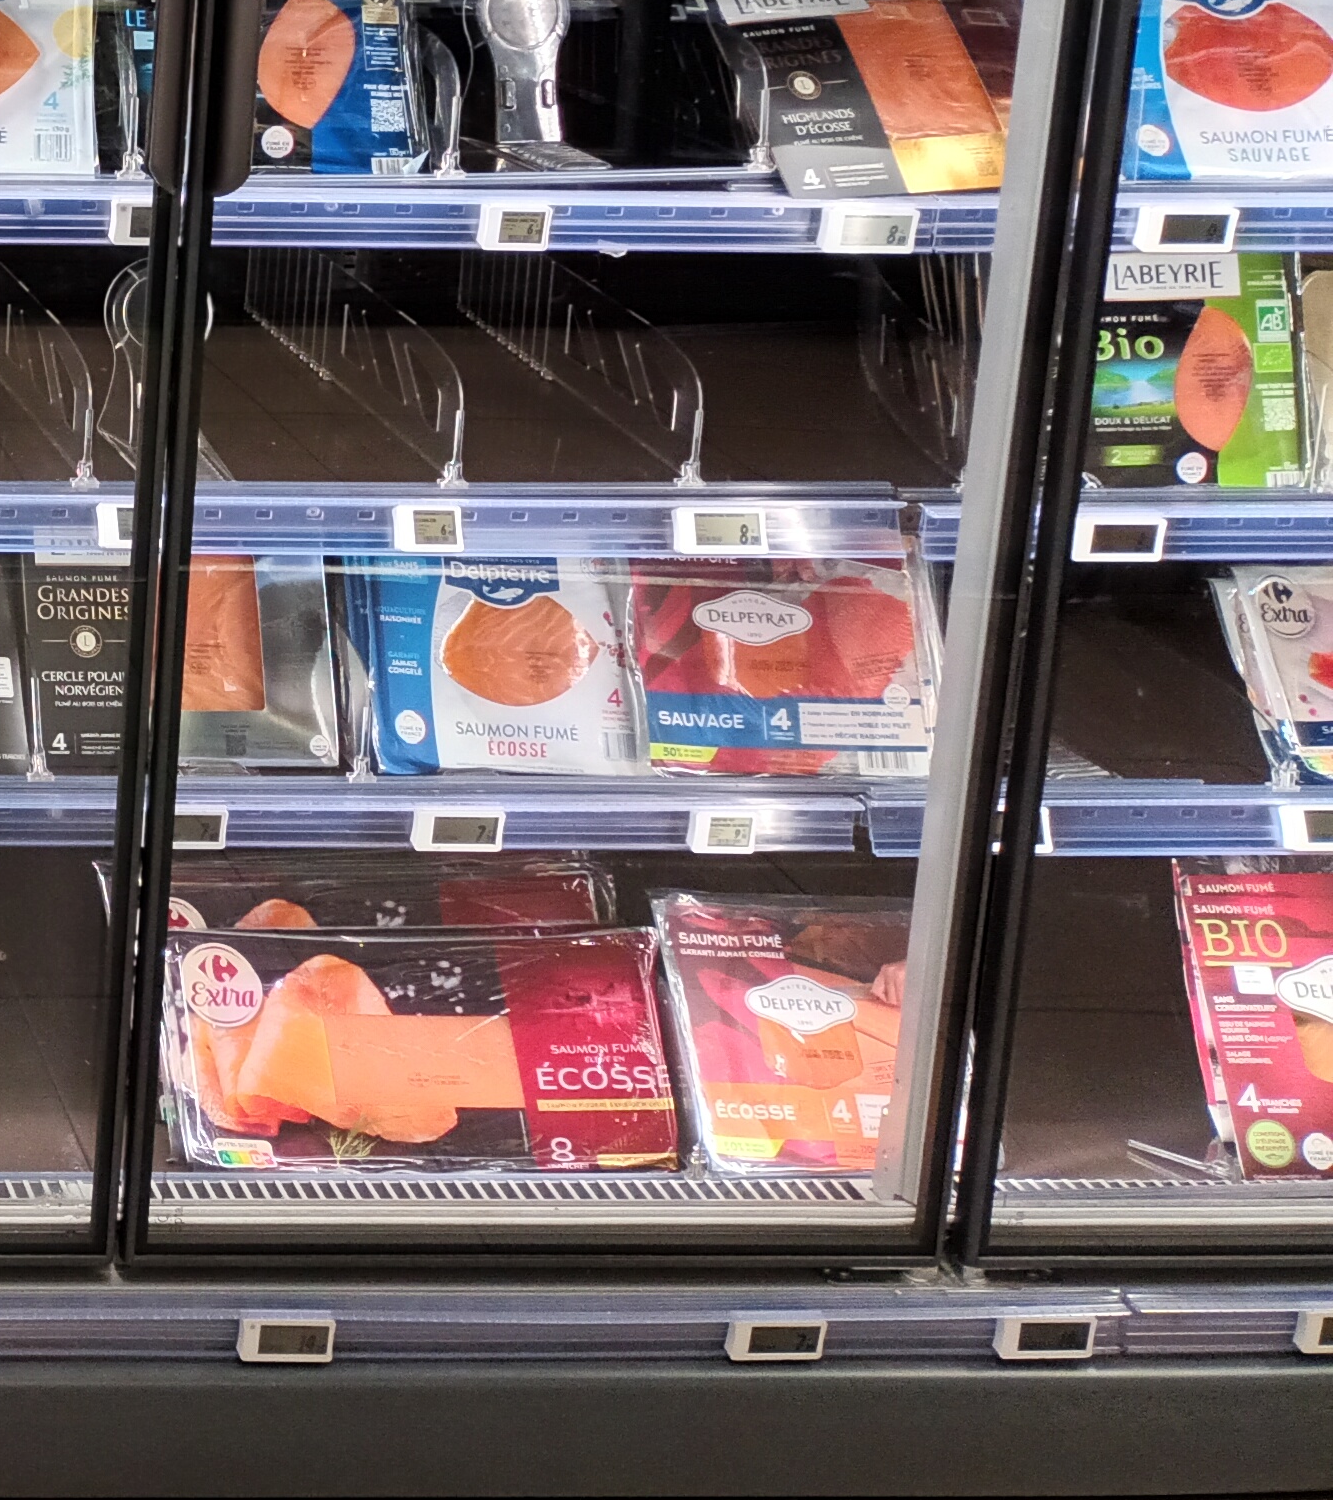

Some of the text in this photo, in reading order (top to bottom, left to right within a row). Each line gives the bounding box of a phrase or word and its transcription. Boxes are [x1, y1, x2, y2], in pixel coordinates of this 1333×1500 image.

[742, 28, 786, 38] SAUMON
[43, 91, 60, 109] 4
[782, 108, 855, 125] HIGHLANDS
[795, 120, 854, 135] D'ÉCOSSE
[1199, 129, 1278, 145] SAUMON
[1228, 147, 1311, 163] SAUVAGE
[802, 168, 821, 187] 4
[1113, 260, 1224, 291] LABEYRIE
[1260, 315, 1285, 331] AB
[1096, 327, 1165, 361] Bio
[1094, 414, 1171, 426] DOUX & DÉLICAT
[1110, 449, 1122, 464] 2
[449, 560, 550, 585] Delpierre
[37, 585, 129, 603] GRANDES
[706, 608, 797, 628] DELPEYRAT
[1260, 601, 1312, 625] Extra
[41, 670, 84, 683] CERCLE
[387, 666, 423, 676] CONGELÉ
[54, 682, 124, 697] NORVÉGIEN
[606, 688, 624, 708] 4
[658, 709, 746, 730] SAUVAGE
[769, 708, 792, 731] 4
[455, 720, 580, 742] SAUMON FUMÉ
[51, 733, 67, 751] 4
[488, 739, 548, 758] ÉCOSSE
[1197, 881, 1276, 894] SAUMON FUMÉ
[1193, 902, 1276, 916] SAUMON FUMÉ
[678, 931, 783, 949] SAUMON FUMÉ
[1194, 918, 1288, 959] BIO
[190, 980, 258, 1010] Extra
[759, 994, 843, 1015] DELPEYRAT
[550, 1043, 608, 1056] SAUMON
[535, 1062, 671, 1092] ÉCOSSE
[1236, 1082, 1260, 1113] 4
[714, 1098, 853, 1122] ÉCOSSE 4
[549, 1136, 574, 1163] 8
